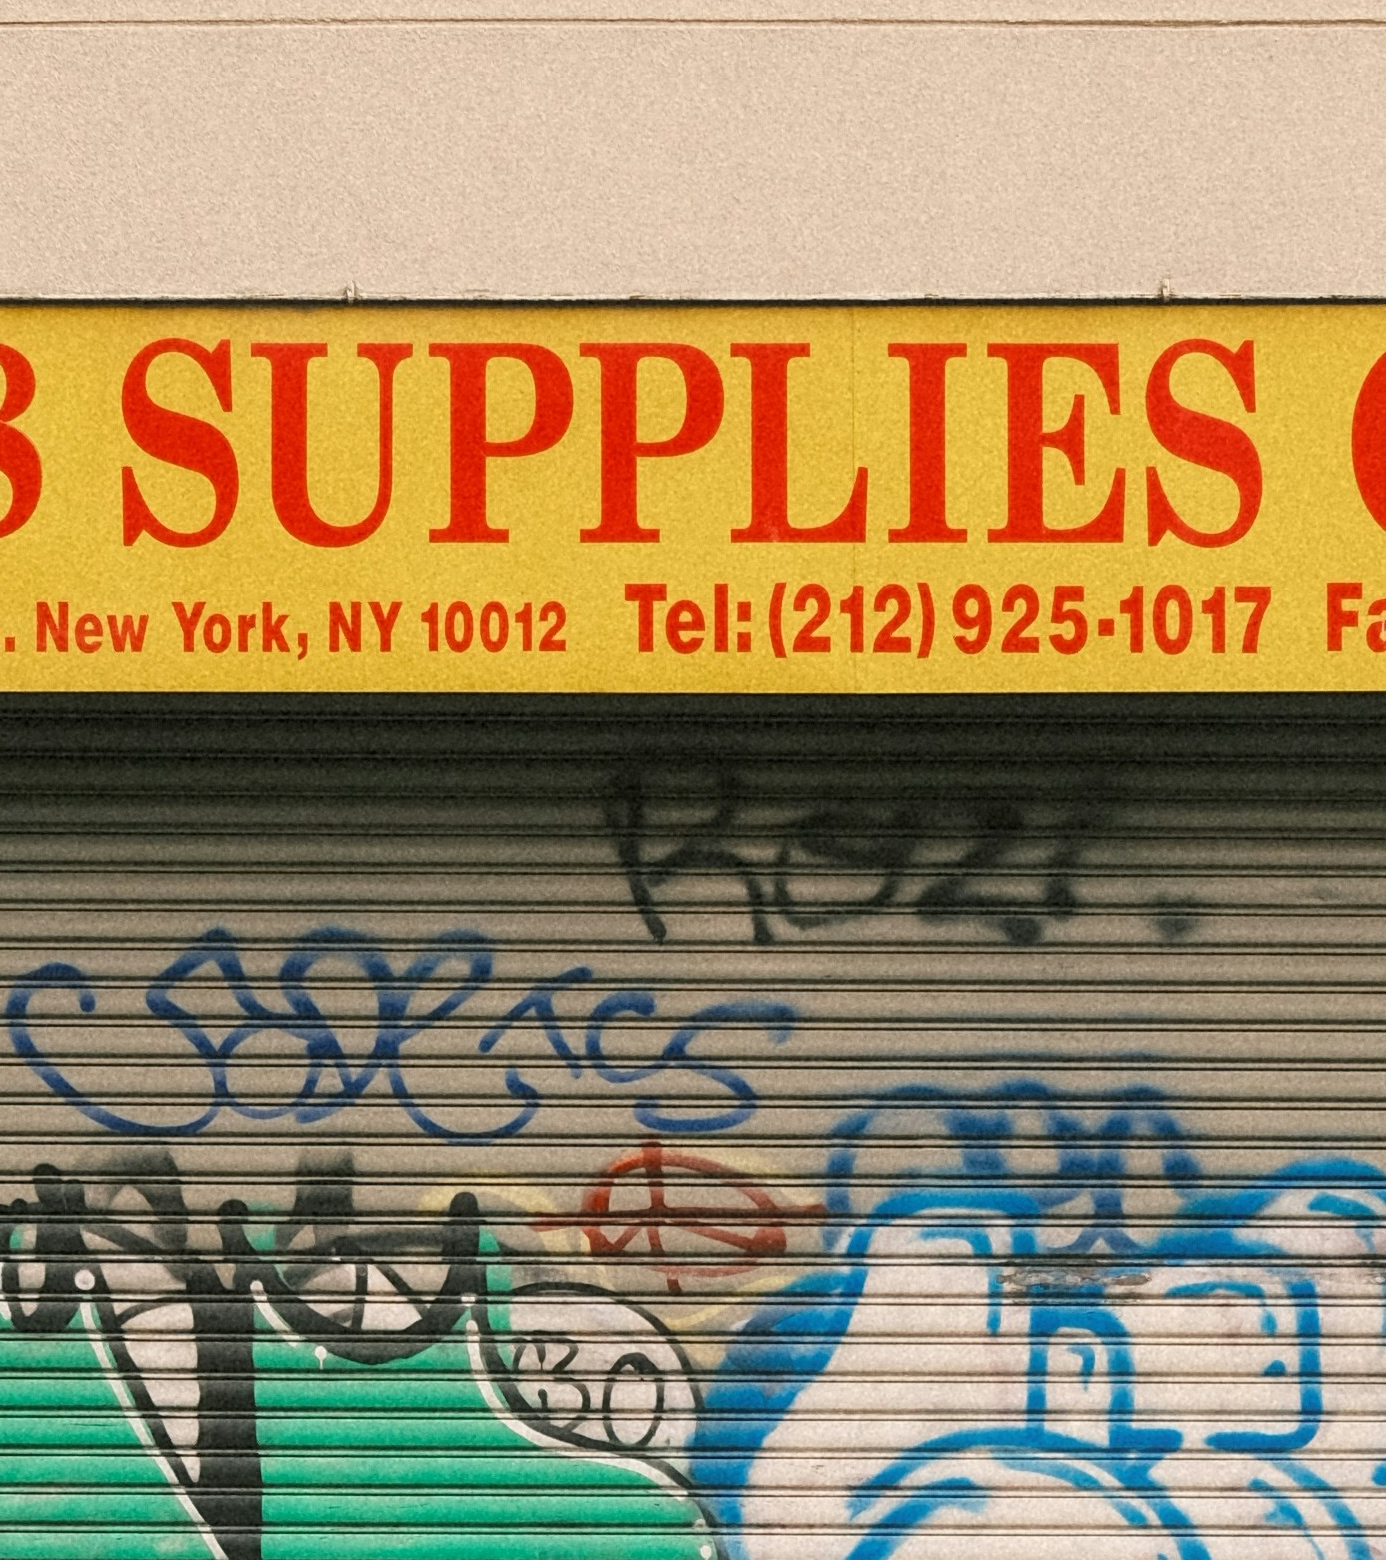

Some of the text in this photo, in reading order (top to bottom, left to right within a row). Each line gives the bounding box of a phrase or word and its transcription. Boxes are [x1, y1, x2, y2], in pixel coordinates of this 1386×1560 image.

[121, 337, 1265, 550] SUPPLIES
[36, 601, 149, 655] New
[172, 601, 310, 662] York,
[329, 601, 404, 654] NY
[421, 601, 568, 655] 10012
